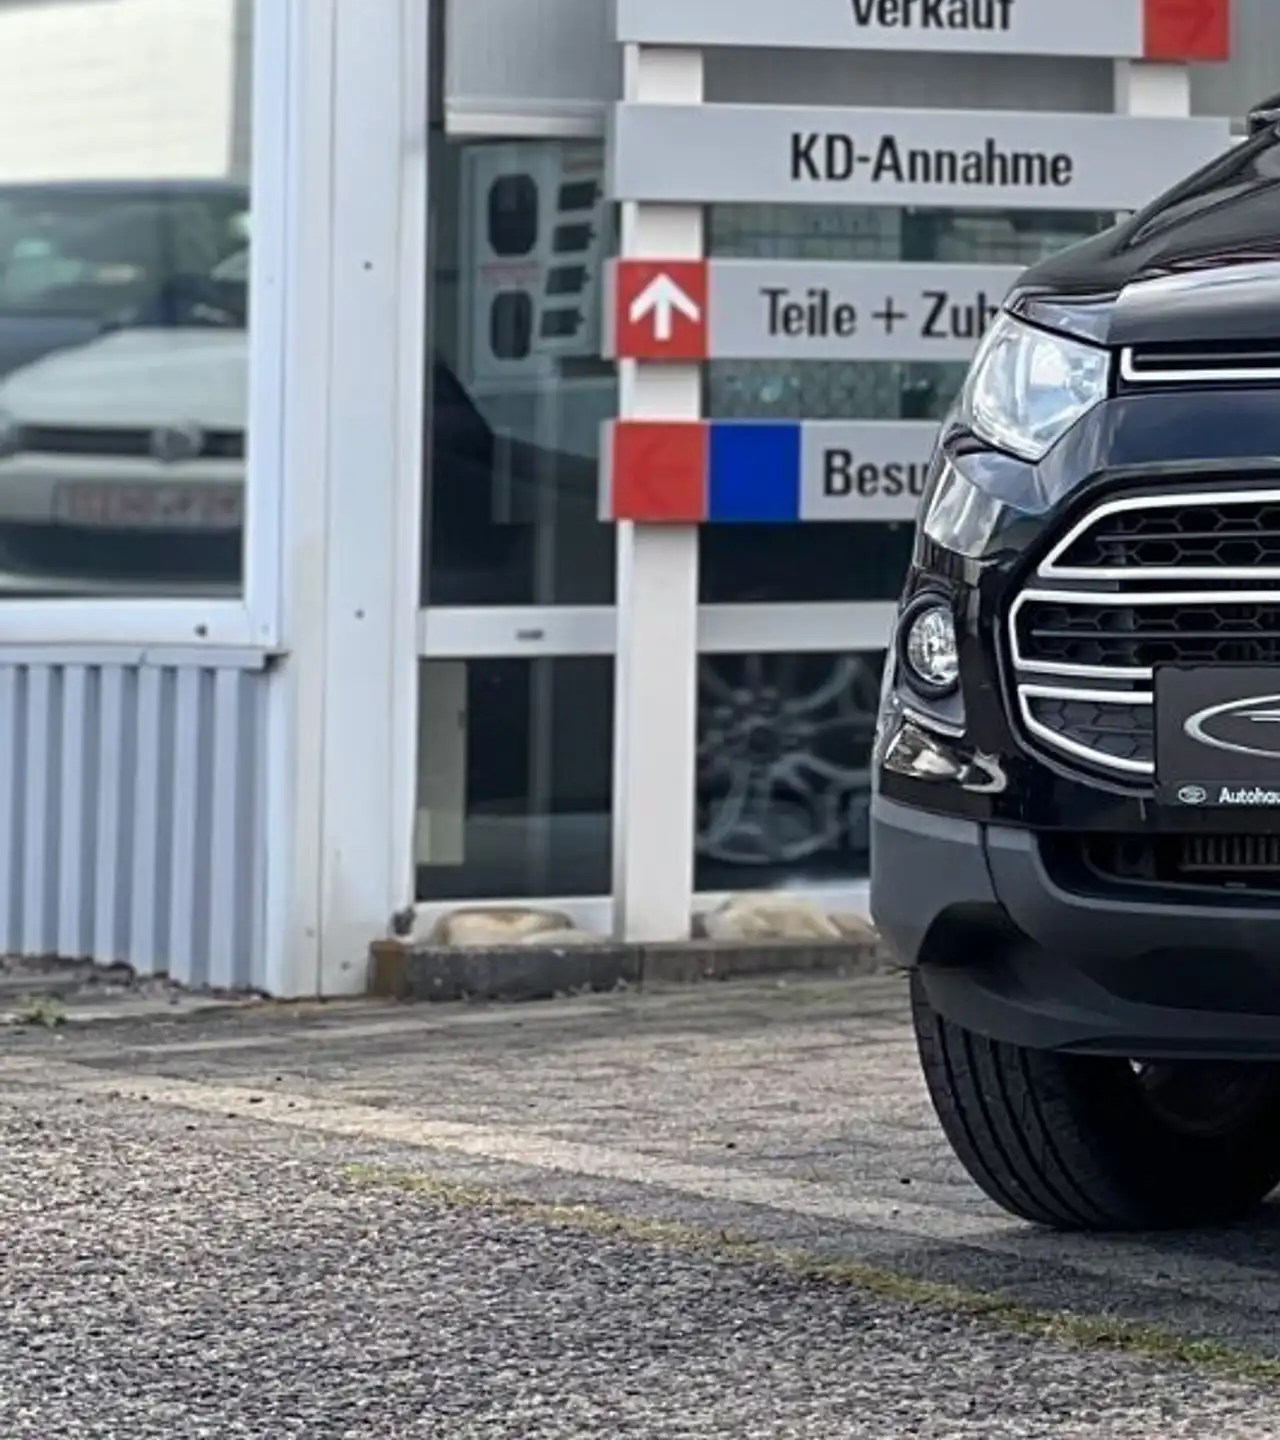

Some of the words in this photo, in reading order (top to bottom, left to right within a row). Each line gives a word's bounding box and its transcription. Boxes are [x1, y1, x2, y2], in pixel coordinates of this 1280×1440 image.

[791, 132, 1074, 187] KD-Annahme
[760, 287, 857, 338] Teile
[871, 296, 908, 335] +
